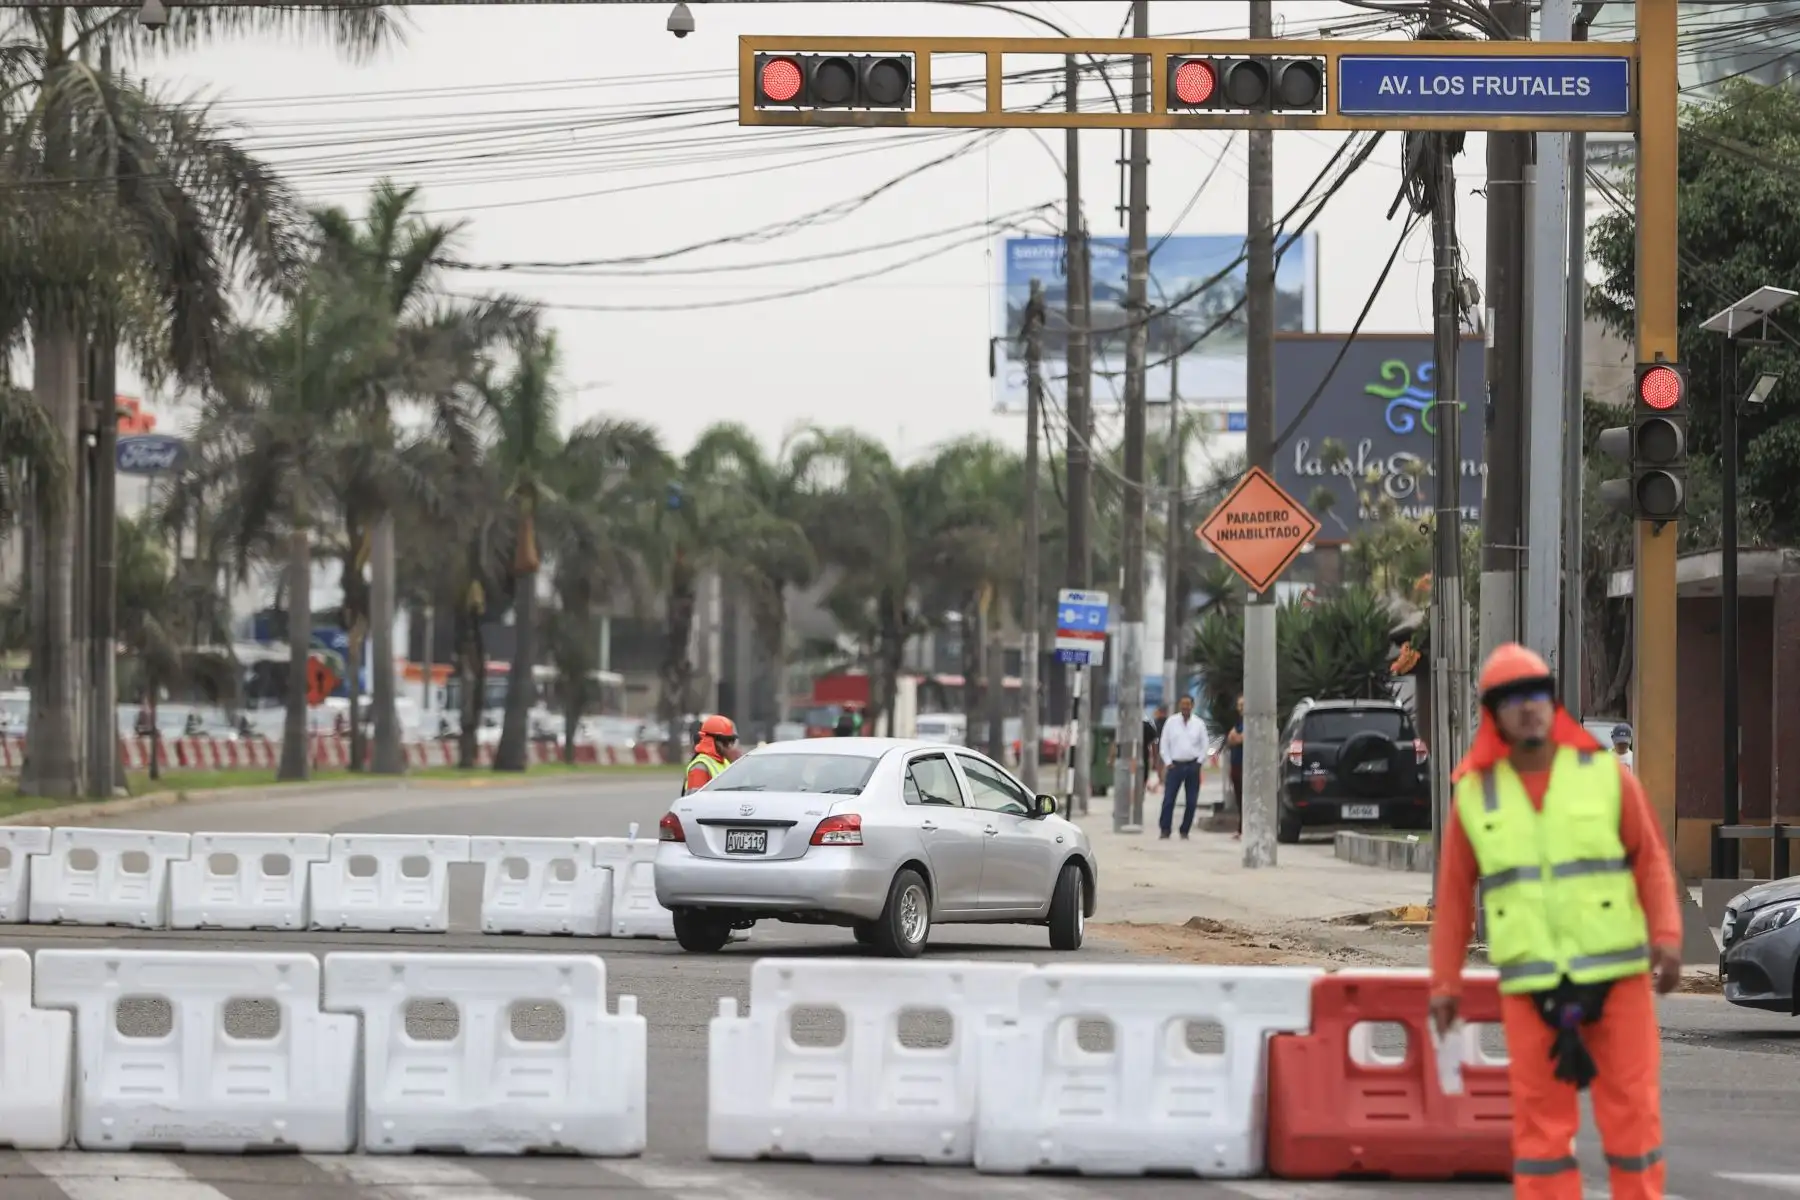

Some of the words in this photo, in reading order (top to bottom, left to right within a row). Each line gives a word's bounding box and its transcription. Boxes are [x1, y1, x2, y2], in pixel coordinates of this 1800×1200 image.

[1378, 75, 1412, 95] AV.
[1419, 75, 1465, 96] LOS
[1472, 76, 1591, 96] FRUTALES
[1226, 510, 1289, 525] PARADERO
[1217, 525, 1300, 541] INHABILITADO
[728, 835, 765, 850] AVU-119
